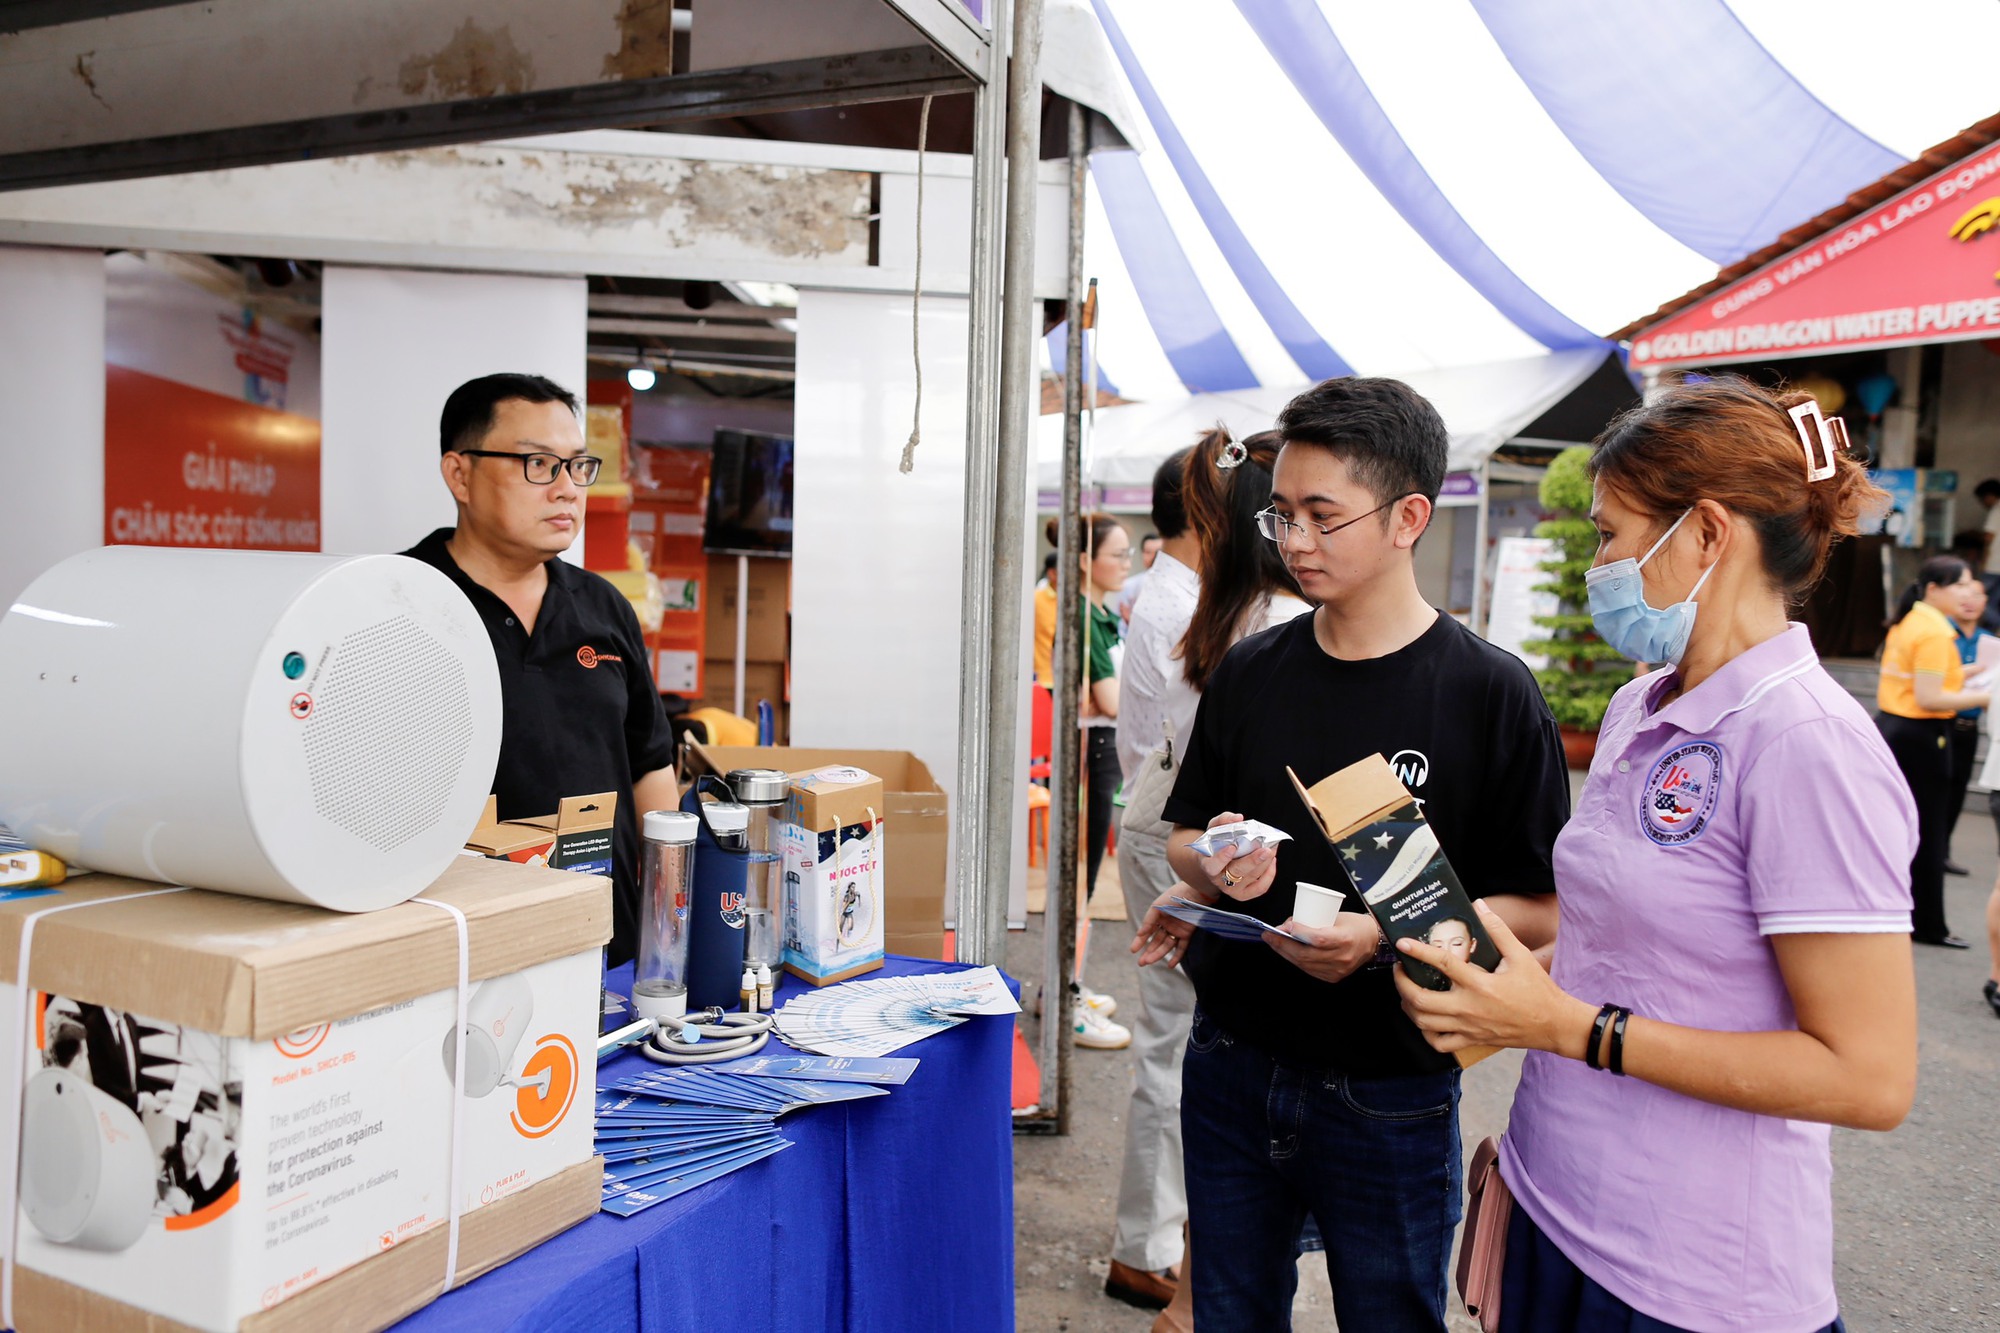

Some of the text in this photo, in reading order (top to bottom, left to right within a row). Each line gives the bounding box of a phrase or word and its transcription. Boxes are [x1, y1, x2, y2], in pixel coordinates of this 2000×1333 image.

[1712, 280, 1773, 319] CUNG
[1880, 193, 1932, 230] LAO
[1650, 329, 1734, 360] GOLDEN
[1735, 318, 1832, 354] DRAGON
[1833, 306, 1914, 342] WATER
[1659, 752, 1680, 770] UNITED
[1389, 887, 1449, 922] Beauty HYDRATING
[1392, 880, 1442, 910] QUANTUM Light
[1408, 901, 1438, 920] Skin Care
[270, 1114, 290, 1131] The
[330, 1091, 351, 1110] first
[267, 1120, 383, 1175] for protection against
[268, 1109, 363, 1156] proven technology
[266, 1154, 356, 1198] the Coronavirus.
[321, 1186, 357, 1209] effective
[357, 1182, 365, 1192] in
[365, 1168, 399, 1190] disabling
[496, 1176, 509, 1188] PLUG
[513, 1169, 526, 1179] PLAY
[397, 1213, 428, 1233] EFFECTIVE
